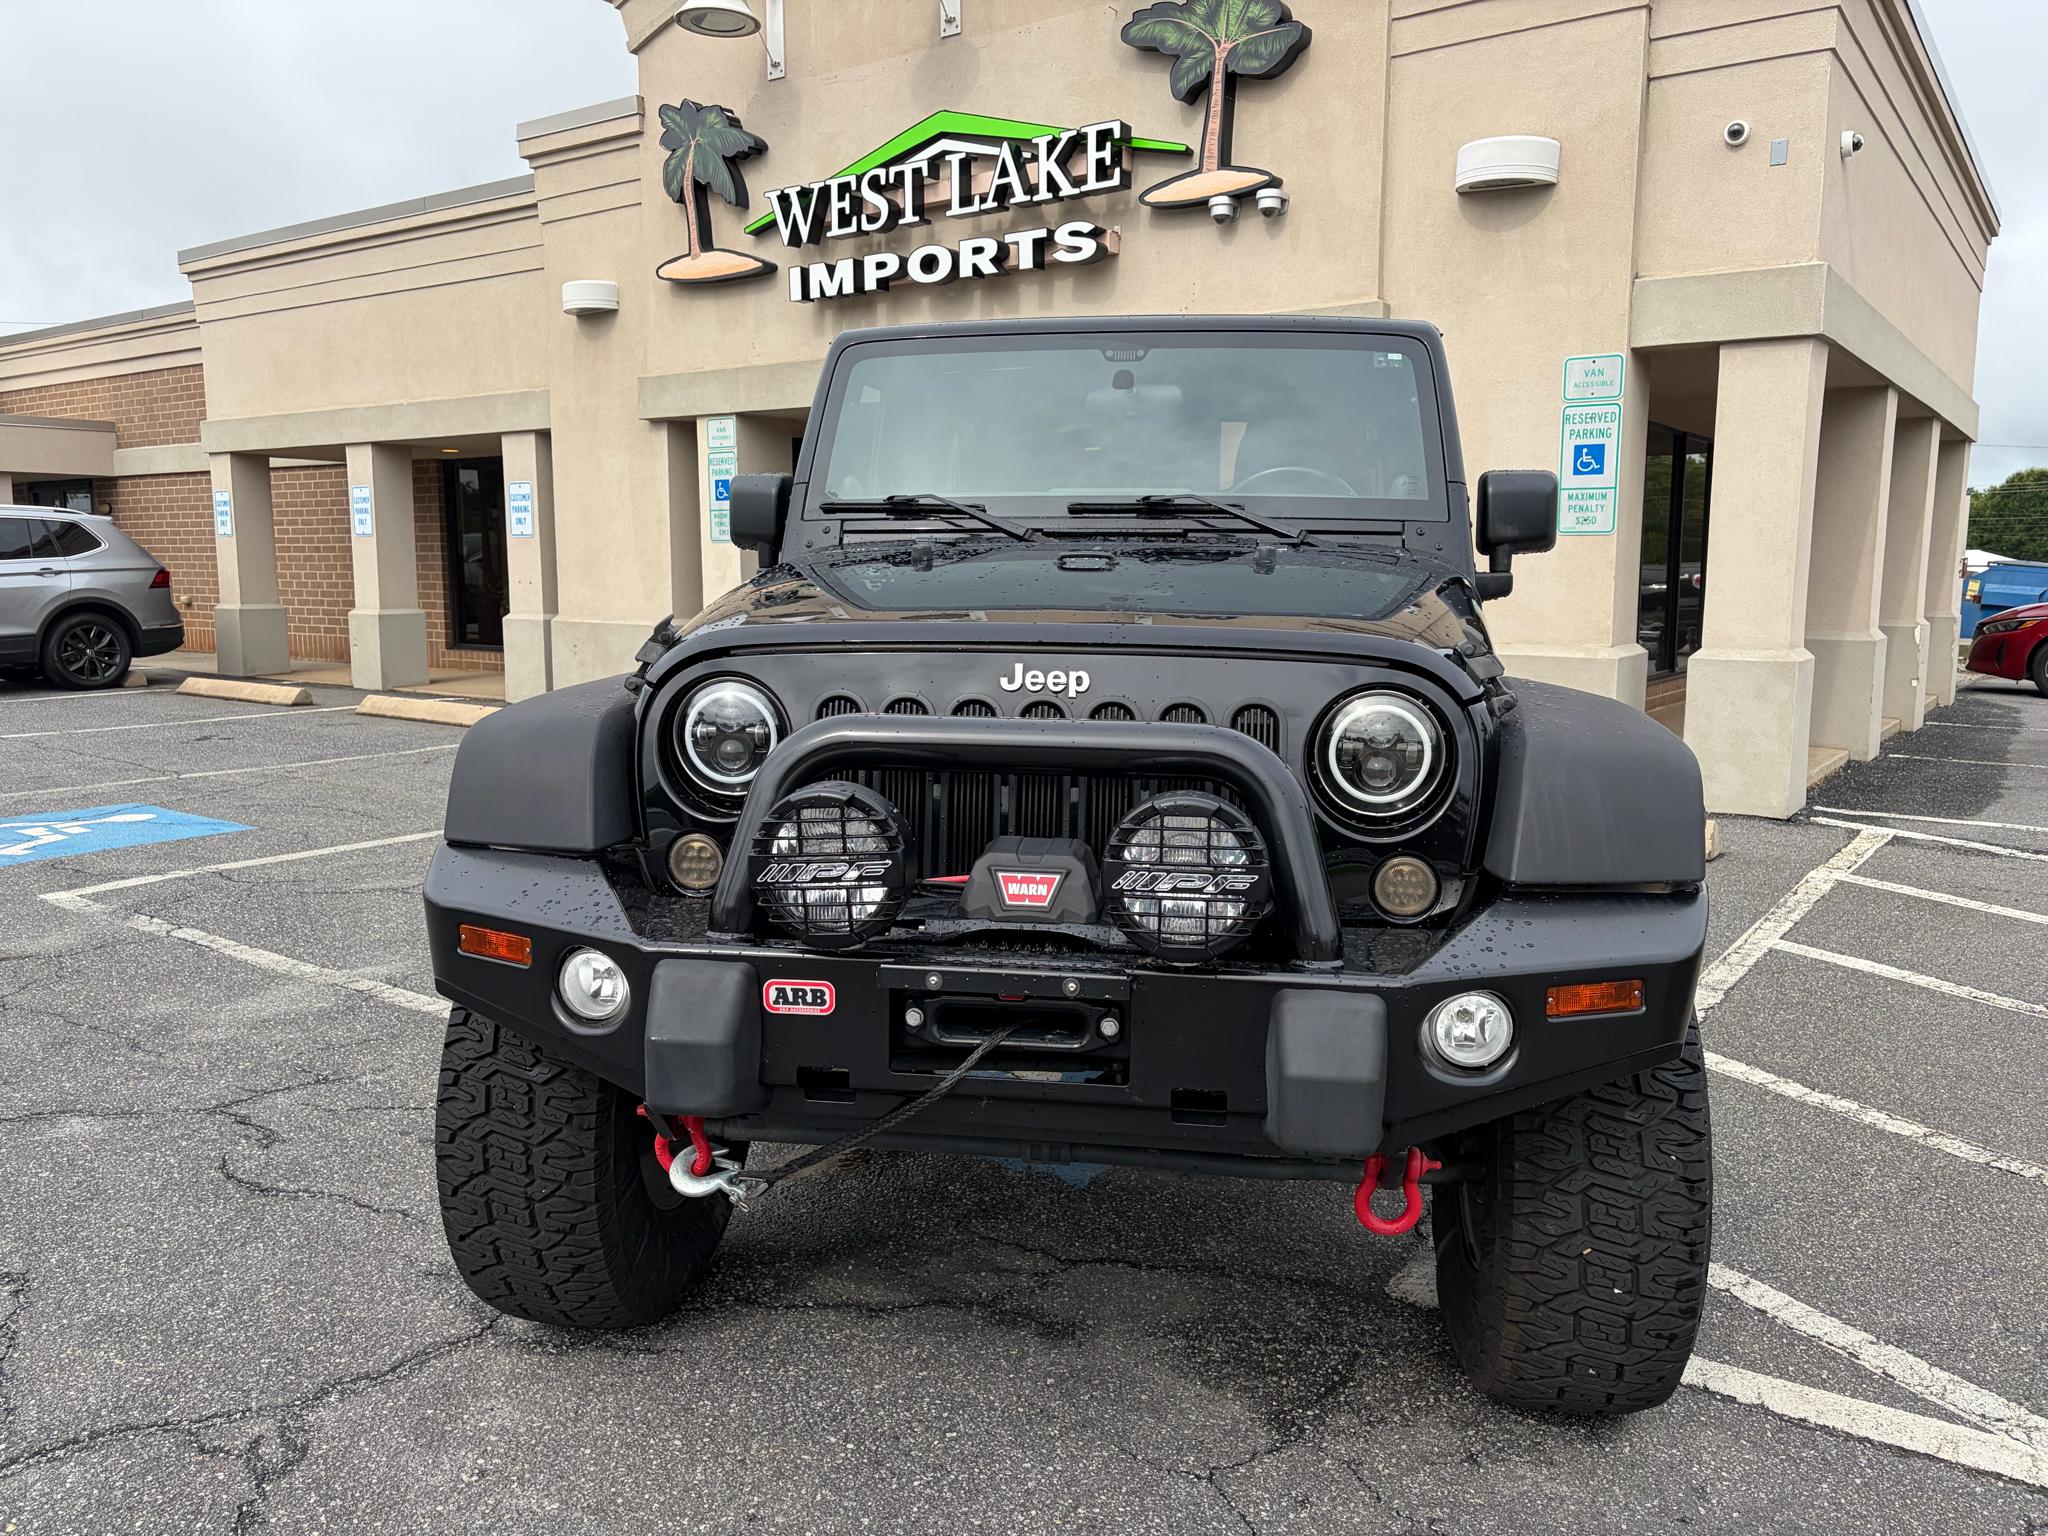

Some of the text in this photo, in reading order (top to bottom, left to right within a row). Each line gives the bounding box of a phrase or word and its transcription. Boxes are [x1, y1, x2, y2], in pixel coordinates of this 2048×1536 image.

[764, 119, 1122, 247] WEST LAKE
[788, 220, 1098, 302] IMPORTS
[1584, 368, 1605, 378] VAN
[1573, 380, 1615, 388] ACCESSIBLE
[1565, 411, 1617, 425] RESERVED
[1569, 427, 1612, 440] PARKING
[1567, 492, 1608, 501] MAXIMUM
[1568, 504, 1606, 513] PENALTY
[1575, 516, 1597, 525] $250
[1000, 662, 1091, 699] Jeep
[1008, 883, 1048, 896] WARN
[772, 987, 828, 1007] ARB
